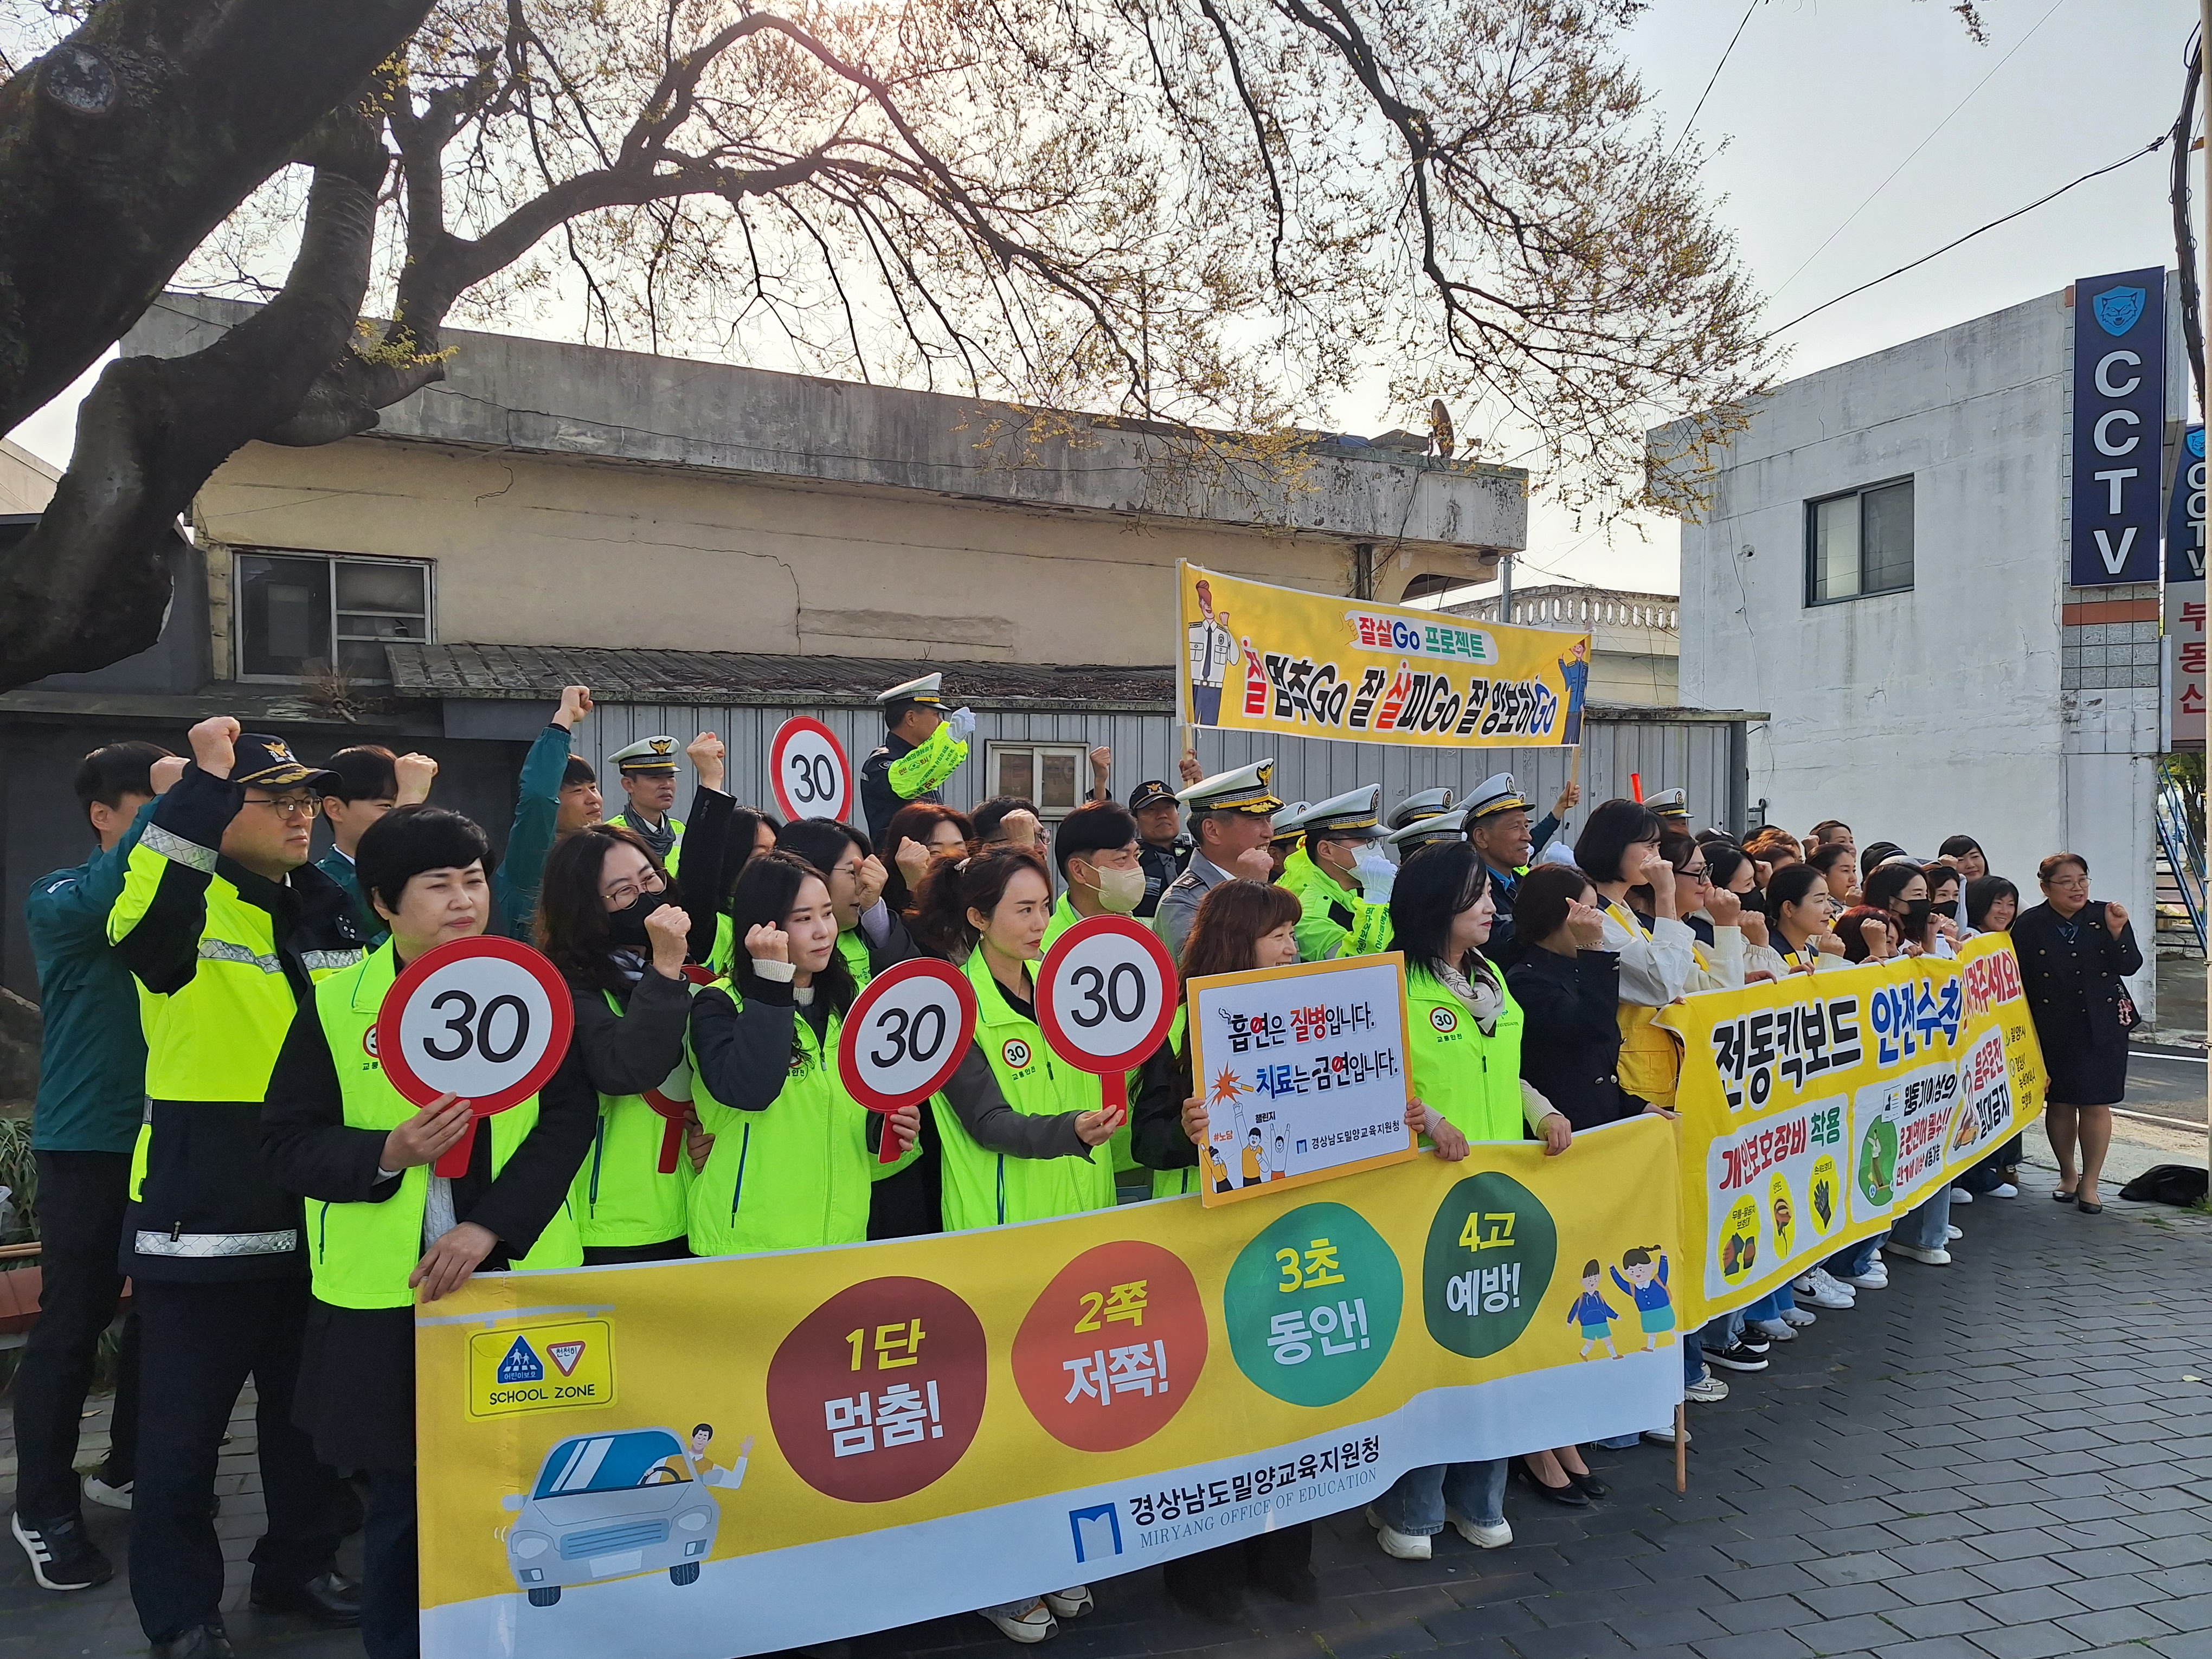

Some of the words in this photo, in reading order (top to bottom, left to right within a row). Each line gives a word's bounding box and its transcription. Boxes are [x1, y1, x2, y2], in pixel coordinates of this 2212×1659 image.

[2093, 350, 2142, 575] CCTV
[1359, 617, 1420, 650] 잘살Go
[1425, 626, 1487, 658] 프로젝트
[1265, 654, 1348, 724] 멈추Go
[1350, 670, 1385, 727] 잘
[1375, 666, 1460, 732] 살피Go
[1456, 680, 1489, 734] 잘
[1481, 680, 1557, 735] 양보하Go
[792, 754, 835, 803] 30
[1070, 962, 1146, 1027] 30
[1435, 1014, 1452, 1026] 30
[422, 990, 530, 1063] 30
[870, 1004, 946, 1068] 30
[1007, 1045, 1025, 1062] 30
[1228, 1012, 1287, 1053] 흡연은
[1290, 1001, 1375, 1043] 질병입니다.
[1714, 999, 1861, 1109] 전동킥보드
[1872, 978, 1962, 1065] 안전수칙
[1256, 1063, 1311, 1100] 치료는
[1311, 1047, 1398, 1091] 금연입니다.
[1975, 1036, 2004, 1091] 음주운전
[1213, 1129, 1233, 1142] #노담
[1255, 1111, 1276, 1123] 챌린지
[1311, 1120, 1400, 1150] 경상남도밀양교육지원청
[1719, 1116, 1806, 1190] 개인보호장비
[1811, 1106, 1841, 1147] 착용
[1458, 1211, 1516, 1253] 4고
[1275, 1237, 1345, 1294] 3초
[1445, 1262, 1521, 1317] 예방!
[1074, 1279, 1148, 1334] 2쪽
[1266, 1297, 1371, 1366] 동안!
[504, 1371, 536, 1380] 어린이보호
[556, 1347, 577, 1358] 천천히
[1062, 1339, 1169, 1406] 저쪽!
[490, 1388, 549, 1405] SCHOOL
[554, 1384, 595, 1399] ZONE
[824, 1380, 944, 1458] 멈춤!
[1129, 1435, 1380, 1526] 경상남도밀양교육지원청
[1140, 1516, 1215, 1548] MIRYANG
[1220, 1499, 1271, 1526] OFFICE
[1276, 1493, 1294, 1509] OF
[1298, 1467, 1378, 1503] EDUCATION
